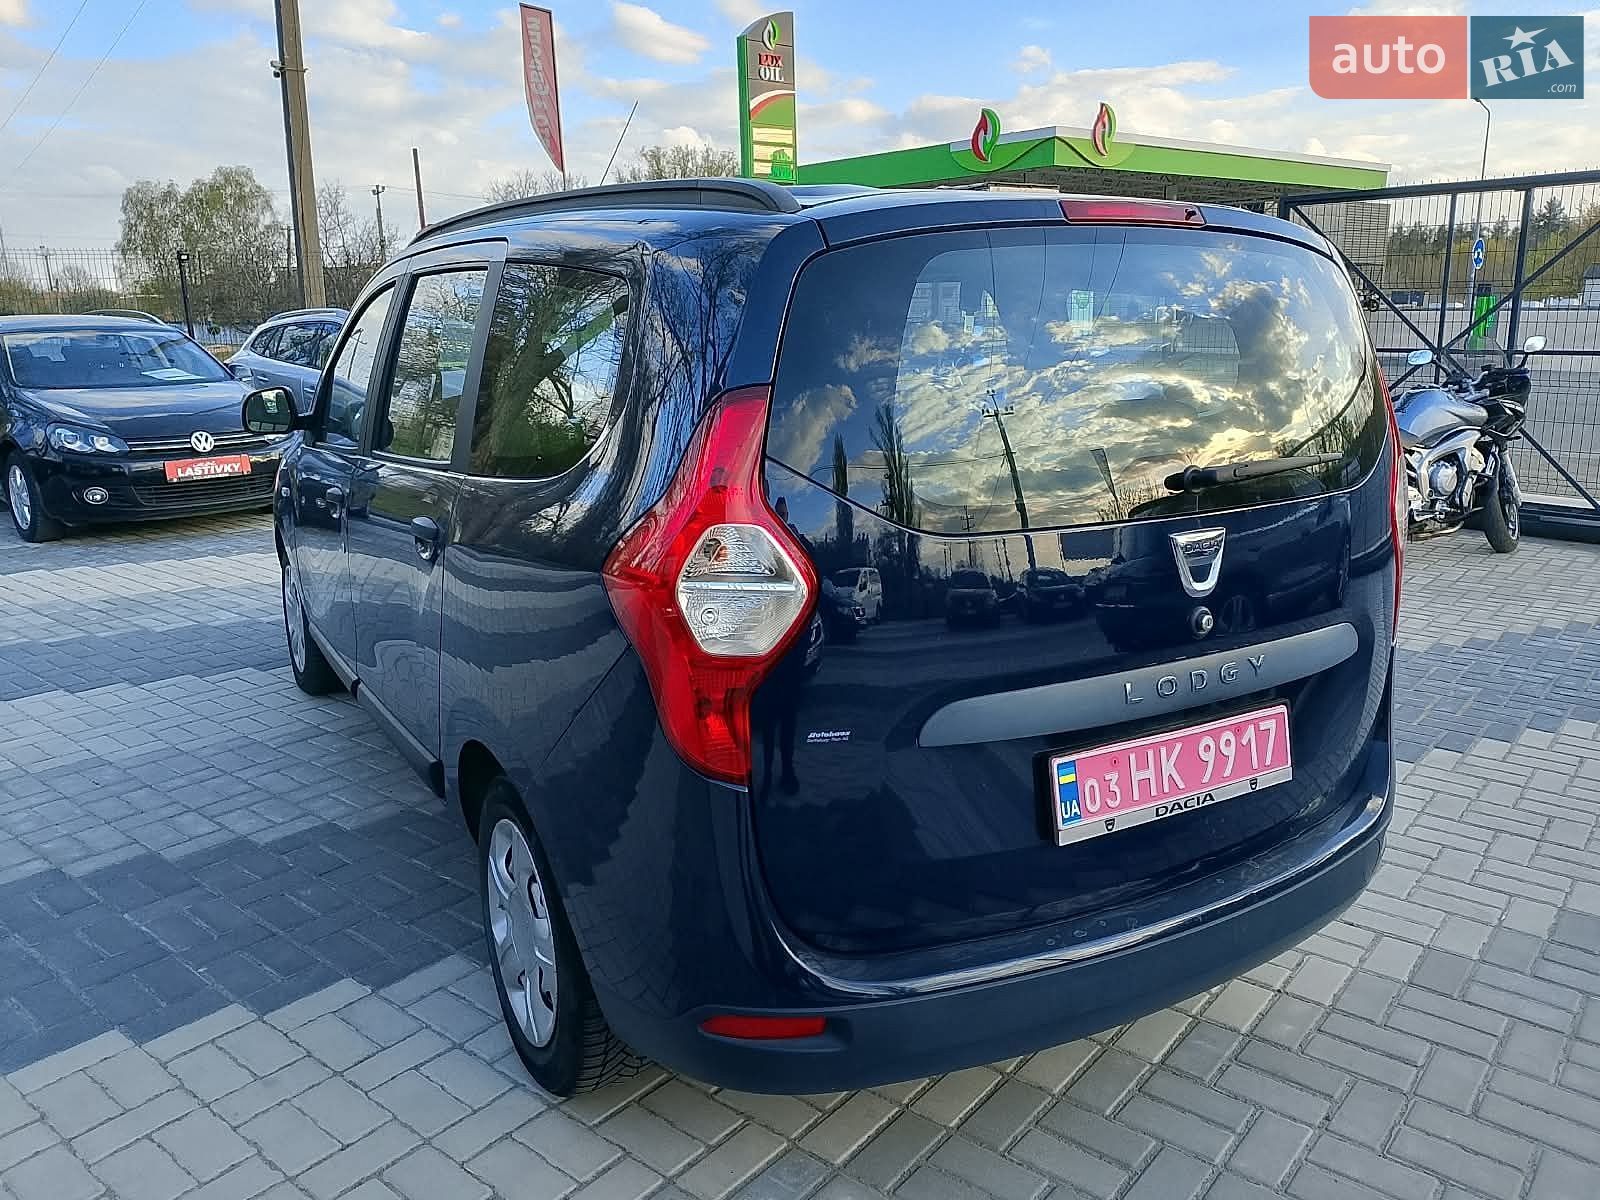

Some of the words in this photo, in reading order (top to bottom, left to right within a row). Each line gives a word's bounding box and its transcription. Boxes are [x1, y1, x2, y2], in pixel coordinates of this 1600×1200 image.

[758, 65, 785, 81] OIL
[1183, 540, 1221, 554] DACIA
[1124, 654, 1265, 704] LODGY
[1083, 771, 1122, 813] 03
[1129, 742, 1186, 802] HK
[1198, 718, 1277, 784] 9917
[1061, 801, 1081, 819] UA
[1155, 792, 1216, 817] DACIA
